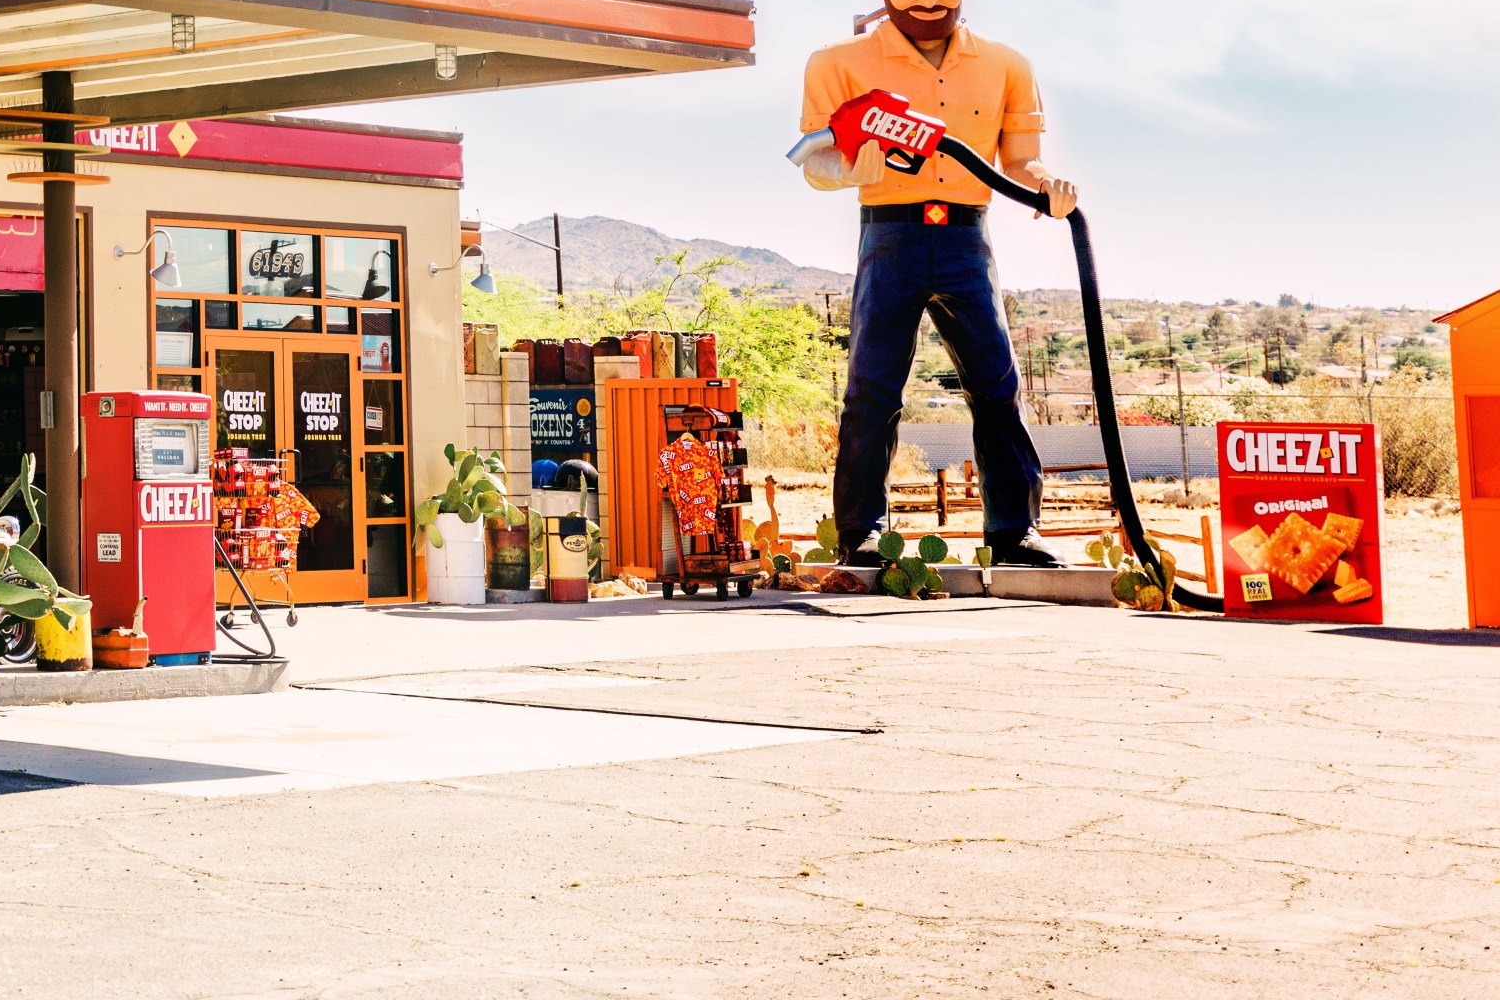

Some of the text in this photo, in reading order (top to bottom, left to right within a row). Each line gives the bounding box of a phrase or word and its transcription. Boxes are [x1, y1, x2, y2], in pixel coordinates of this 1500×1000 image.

[250, 250, 304, 278] 61943
[144, 401, 161, 411] WANT
[168, 402, 182, 412] NEED
[529, 397, 568, 413] Souvenir
[229, 413, 263, 431] STOP
[306, 415, 339, 431] STOP
[1245, 580, 1268, 589] 100%
